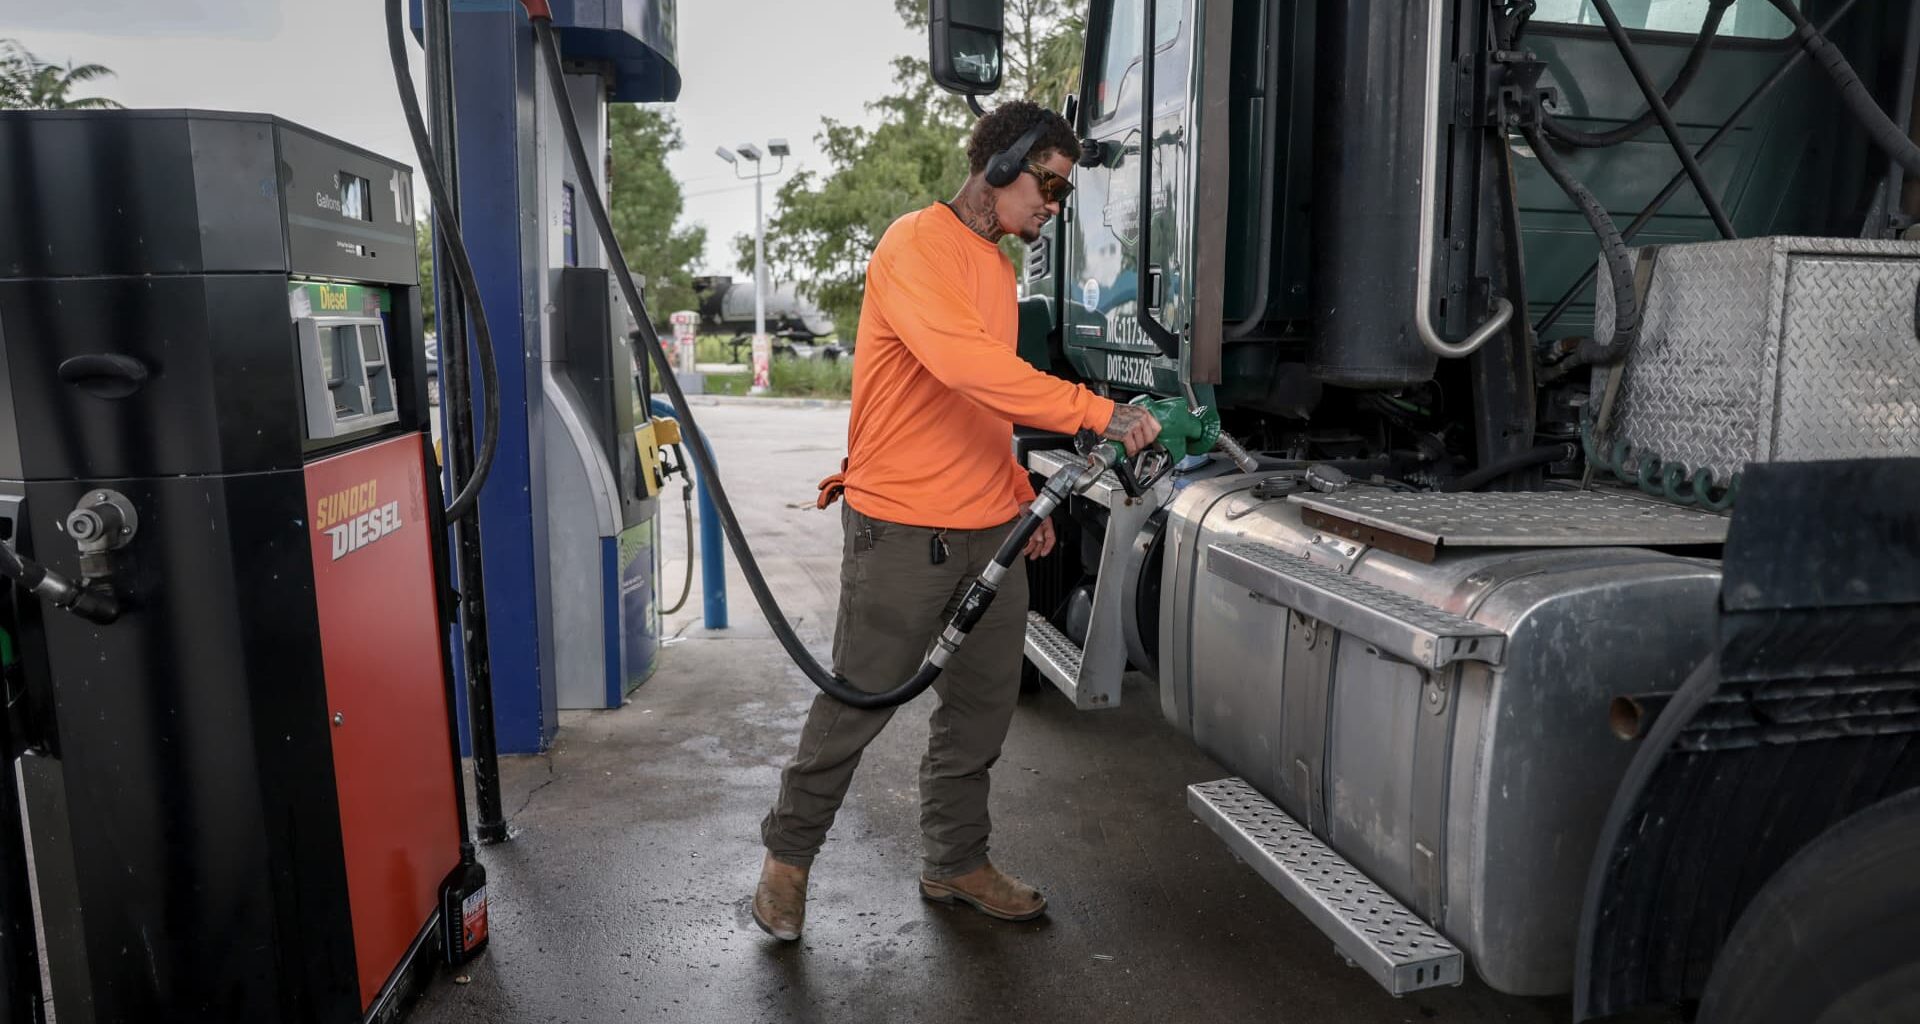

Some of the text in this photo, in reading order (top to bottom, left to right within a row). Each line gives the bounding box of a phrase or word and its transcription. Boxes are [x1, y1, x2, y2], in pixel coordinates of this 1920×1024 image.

[316, 191, 341, 212] Gallons
[390, 169, 413, 226] 10
[319, 285, 348, 311] Diesel
[316, 480, 377, 530] SUNOCO
[323, 500, 402, 561] DIESEL
